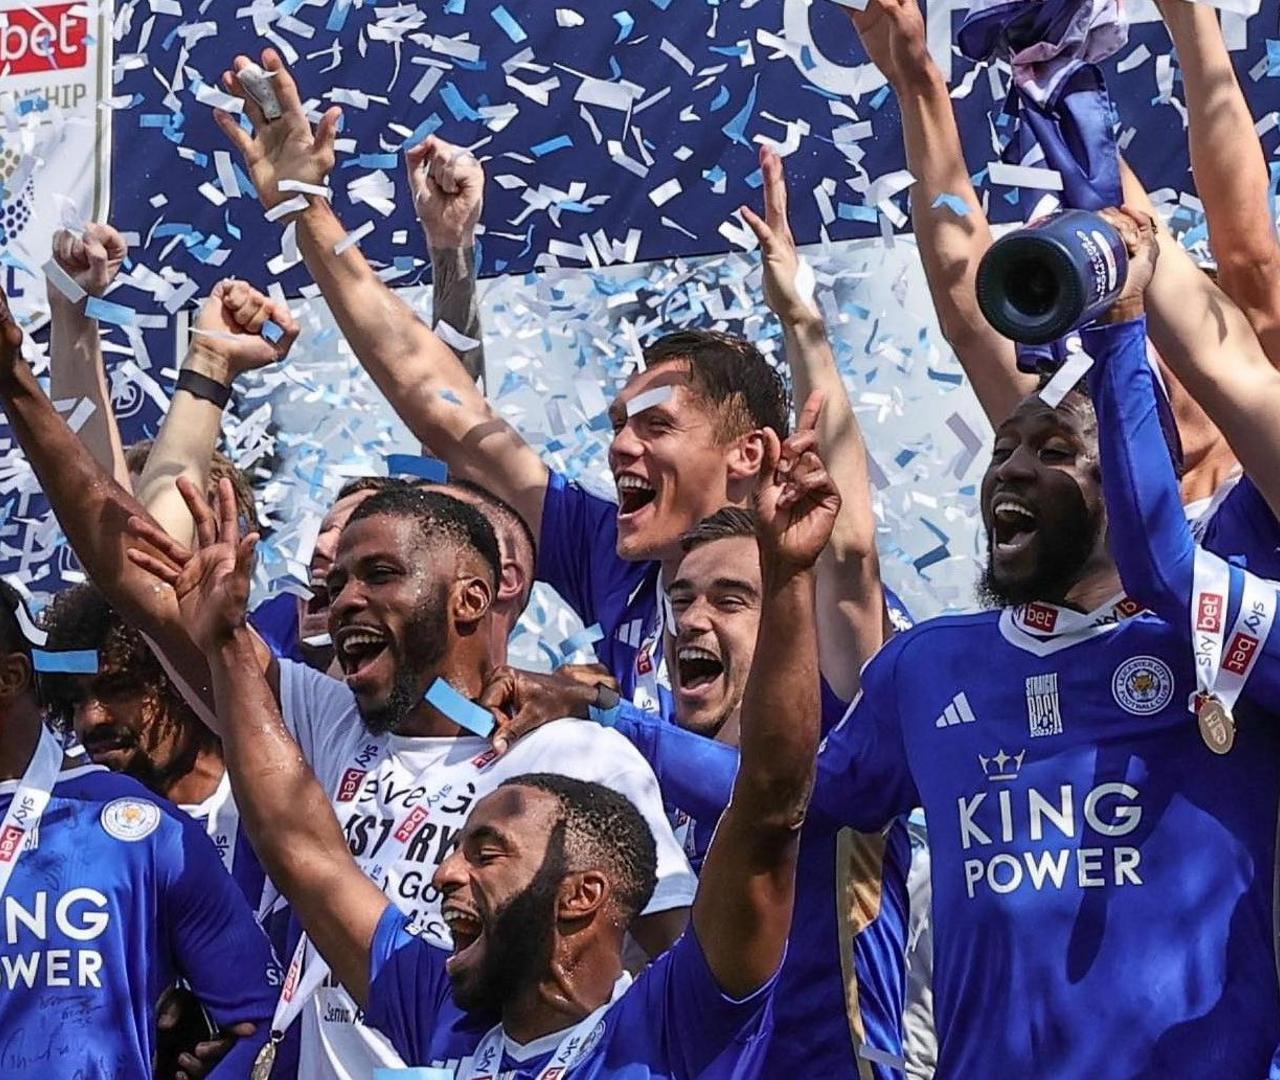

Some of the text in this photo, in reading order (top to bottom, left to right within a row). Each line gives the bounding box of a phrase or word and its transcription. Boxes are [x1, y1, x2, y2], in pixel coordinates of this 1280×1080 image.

[1027, 606, 1052, 629] bet
[1197, 596, 1220, 666] sky bet
[1228, 601, 1265, 673] sky bet
[340, 744, 378, 799] sky bet
[12, 795, 34, 827] sky
[397, 808, 427, 840] bet
[958, 782, 1143, 850] KING
[965, 846, 1143, 898] POWER
[474, 1046, 493, 1076] sky
[558, 1035, 580, 1067] sky
